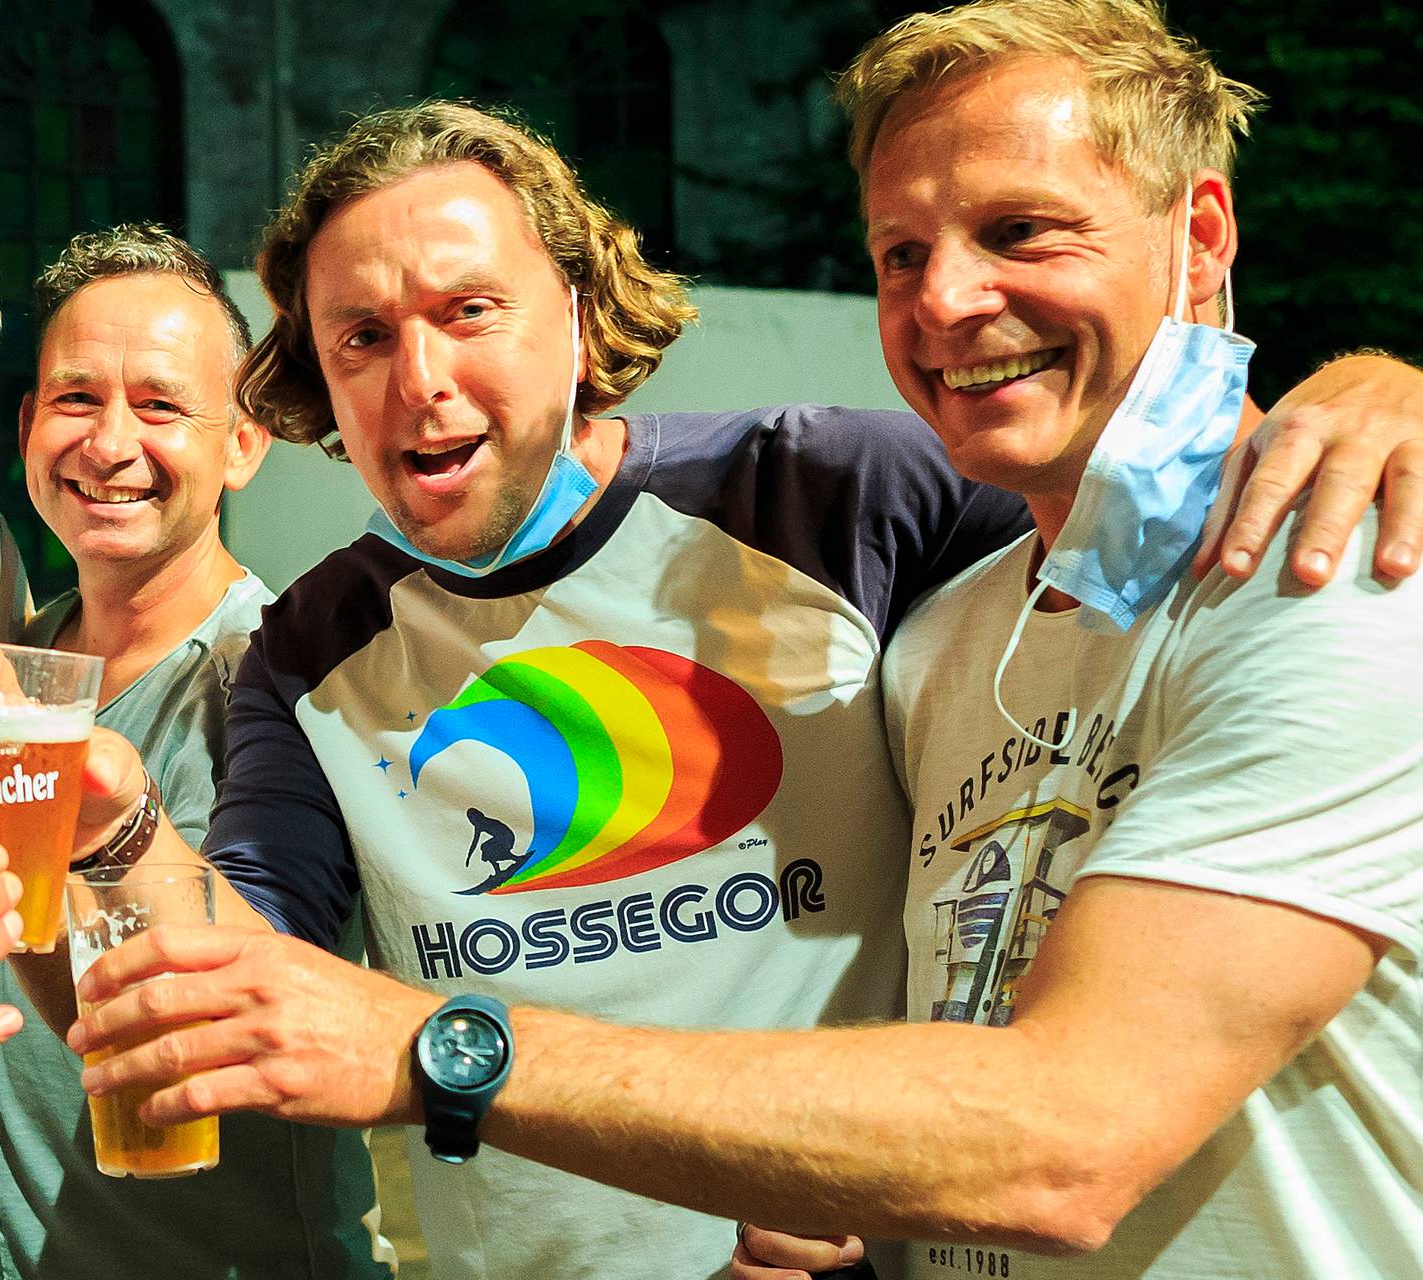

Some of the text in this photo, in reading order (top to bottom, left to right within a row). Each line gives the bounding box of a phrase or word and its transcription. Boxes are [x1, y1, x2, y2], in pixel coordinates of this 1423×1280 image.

[919, 711, 1140, 868] SURFSIDE BEC
[411, 857, 826, 981] HOSSEGOR
[929, 1246, 1010, 1278] est.1988
